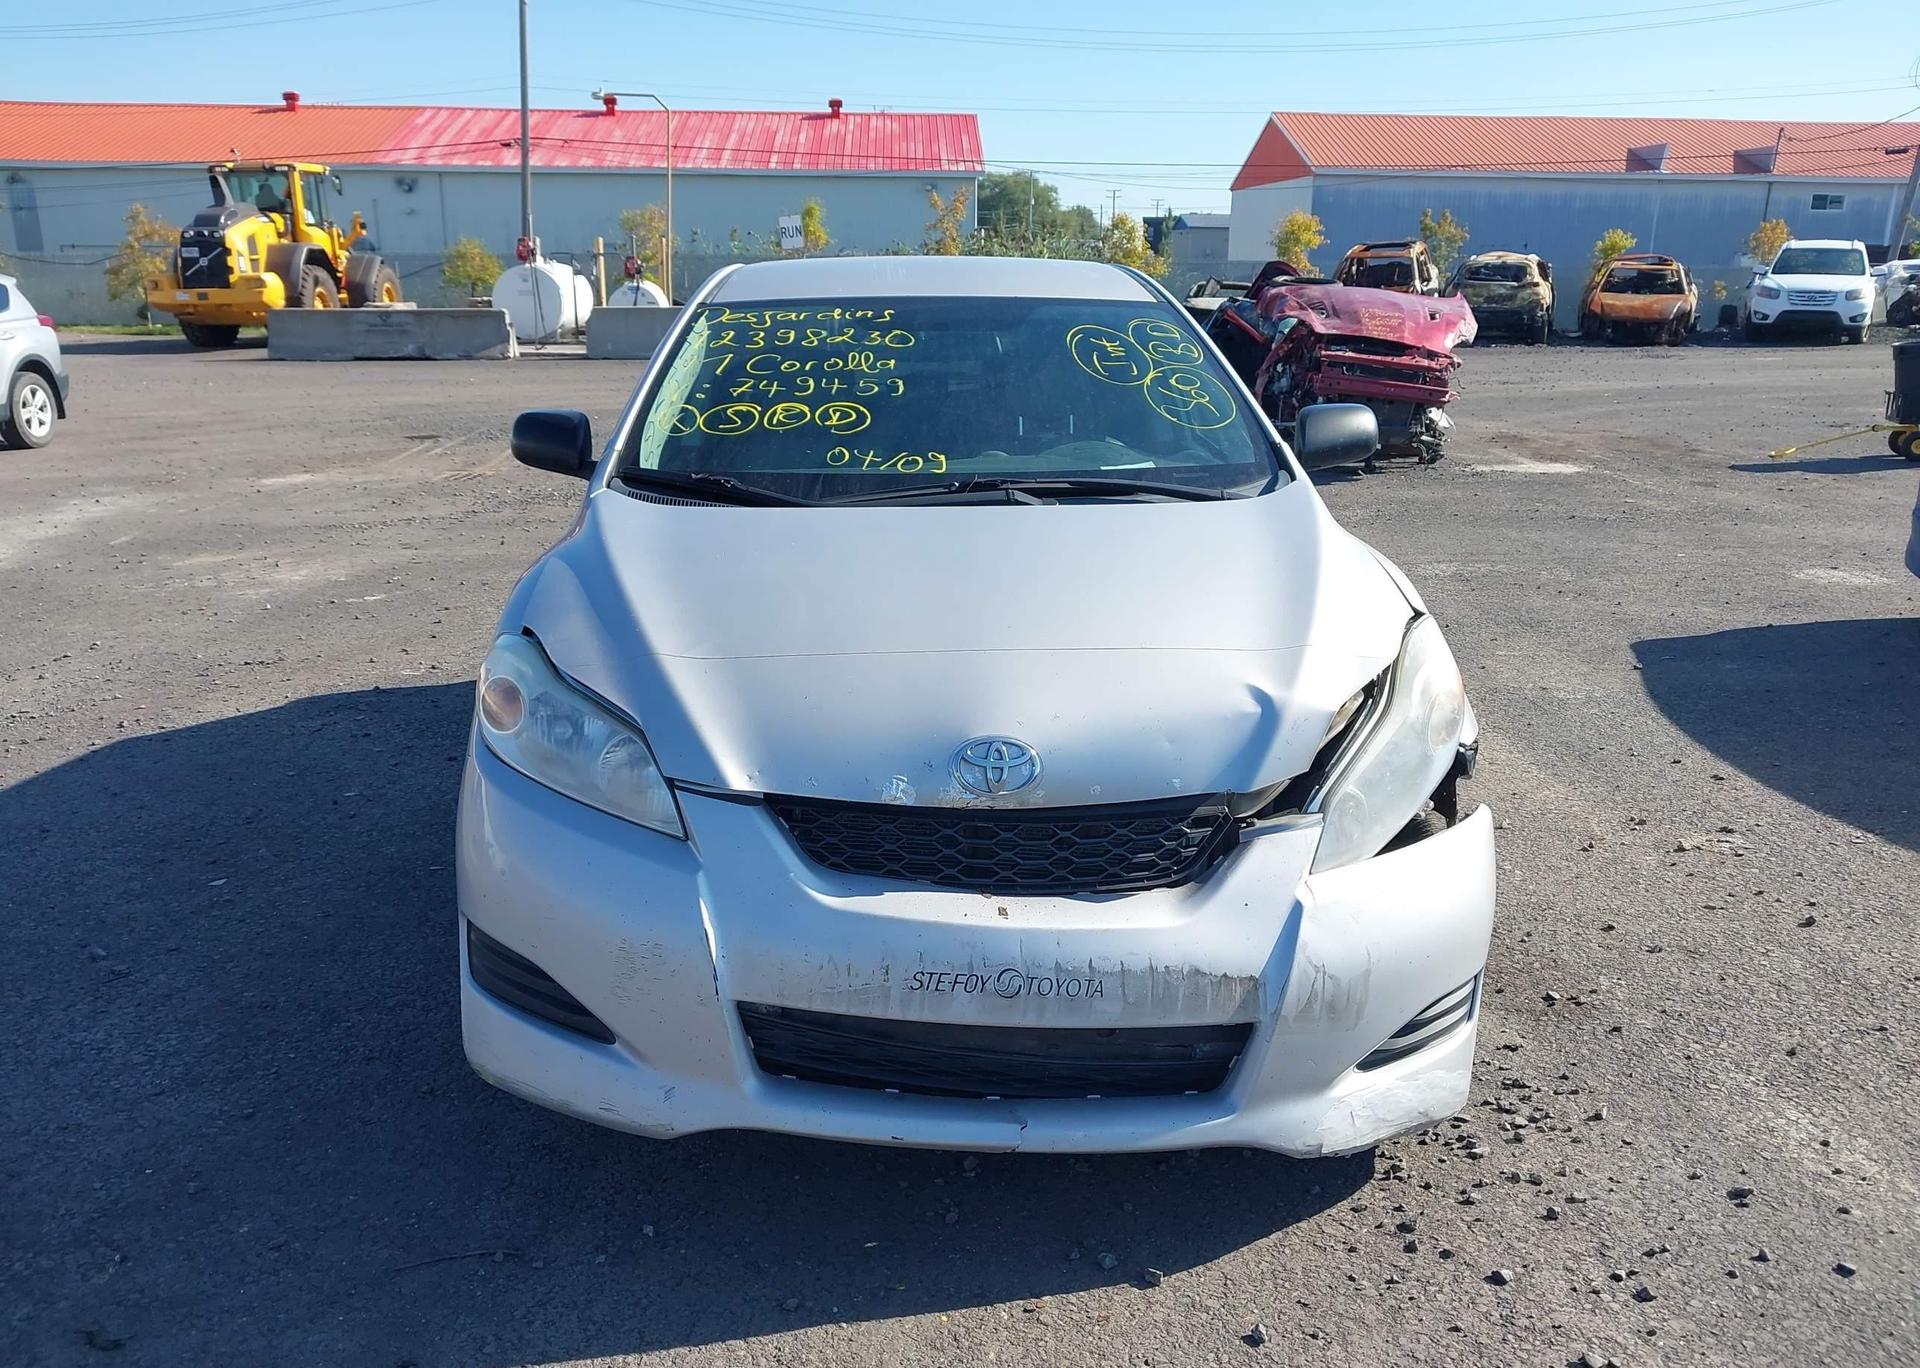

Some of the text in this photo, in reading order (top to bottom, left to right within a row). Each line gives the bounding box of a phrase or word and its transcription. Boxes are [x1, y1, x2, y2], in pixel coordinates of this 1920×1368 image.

[780, 225, 803, 239] RUN
[746, 351, 896, 375] Corolla
[1027, 976, 1105, 998] TOYOTA
